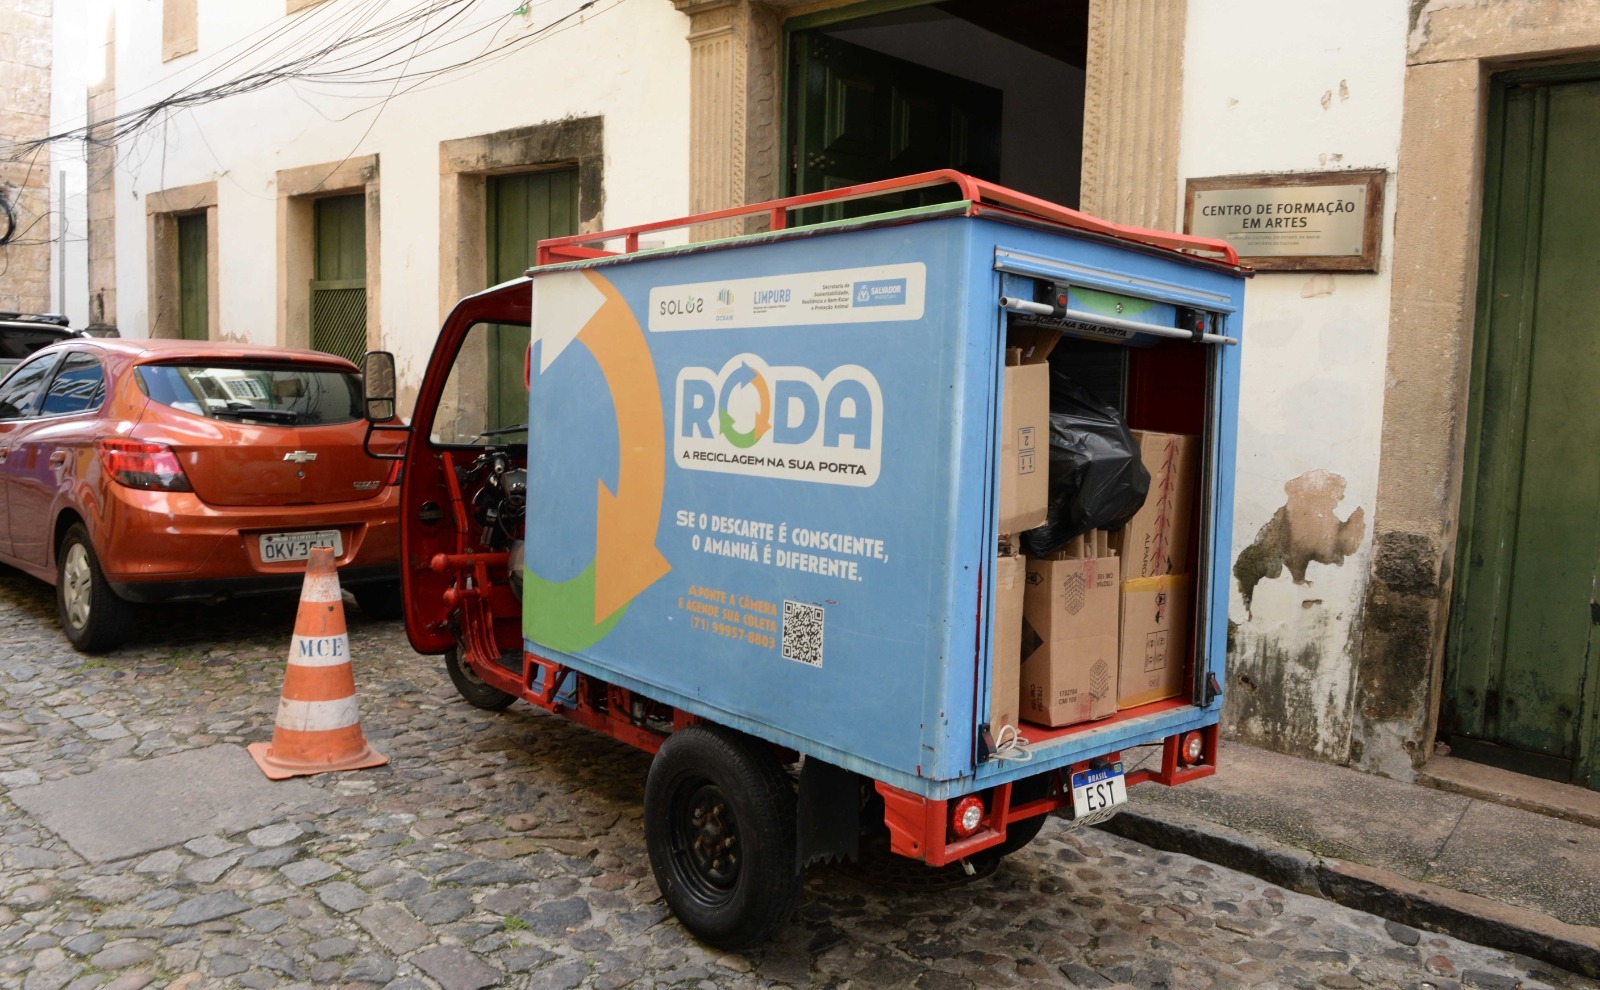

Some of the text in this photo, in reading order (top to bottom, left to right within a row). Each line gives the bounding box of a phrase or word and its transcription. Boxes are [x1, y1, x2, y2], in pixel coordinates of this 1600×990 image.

[1202, 200, 1355, 216] CENTRO DE FORMAÇÃO
[1242, 216, 1307, 229] EM ARTES
[754, 289, 791, 304] LIMPURB
[870, 285, 901, 295] SALVADOR
[1062, 321, 1076, 329] NA
[1078, 323, 1096, 332] SUA
[1097, 327, 1127, 337] PORTA
[682, 360, 872, 449] RODA
[682, 450, 867, 475] A RECICLAGEM NA SUA PORTA
[676, 510, 889, 564] SE O DESCARTE É CONSCIENTE,
[692, 535, 862, 582] O AMANHÃ É DIFERENTE.
[688, 585, 777, 616] APONTE A CÂMERA
[678, 597, 776, 633] E AGENDE SUA COLETA
[691, 614, 776, 649] (71) 99957-8803
[299, 638, 342, 657] MCE
[1088, 772, 1107, 783] BRASIL
[1086, 781, 1114, 811] EST
